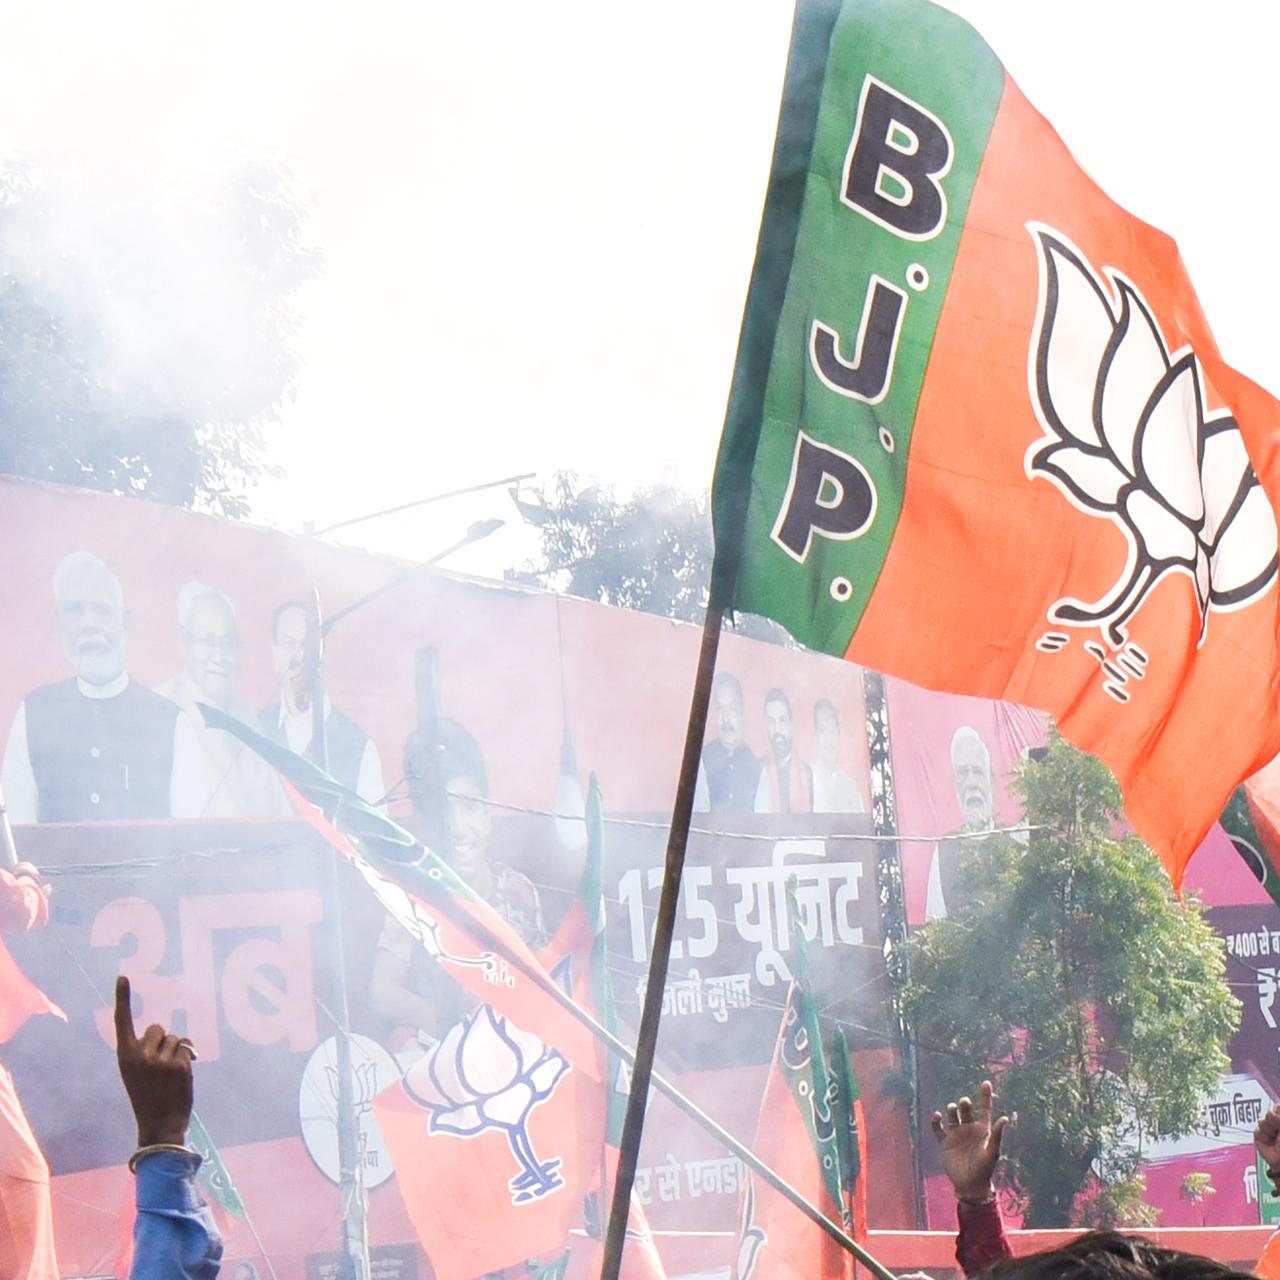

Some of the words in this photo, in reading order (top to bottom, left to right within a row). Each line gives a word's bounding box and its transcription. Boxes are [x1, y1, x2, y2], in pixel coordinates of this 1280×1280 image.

[726, 840, 863, 986] यूनिट
[1258, 925, 1270, 955] से
[1233, 1092, 1262, 1126] बिहार
